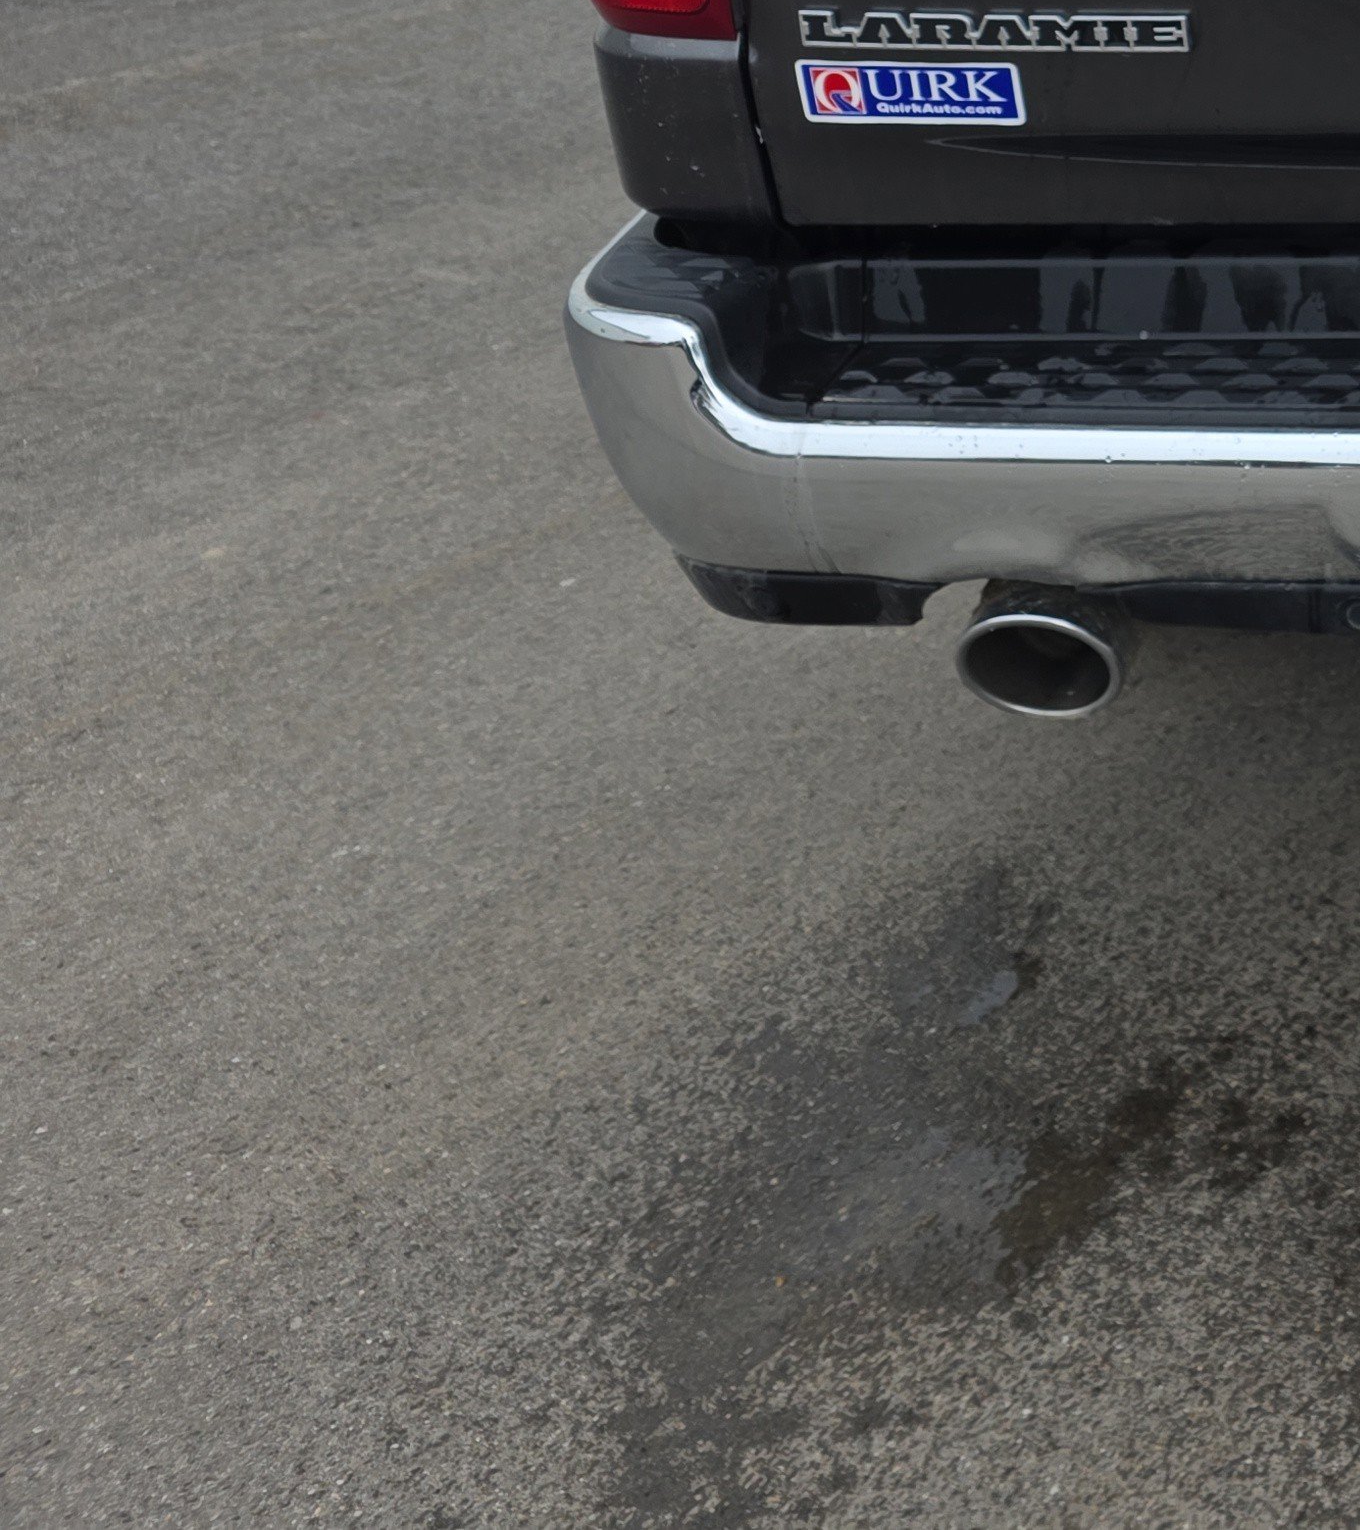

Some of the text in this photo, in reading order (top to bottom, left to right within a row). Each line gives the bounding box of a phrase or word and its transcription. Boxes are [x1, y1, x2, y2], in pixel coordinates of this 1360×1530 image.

[798, 8, 1190, 53] LARAMIE
[813, 68, 1008, 114] QUIRK
[876, 101, 1003, 115] QuirkAuto.com
